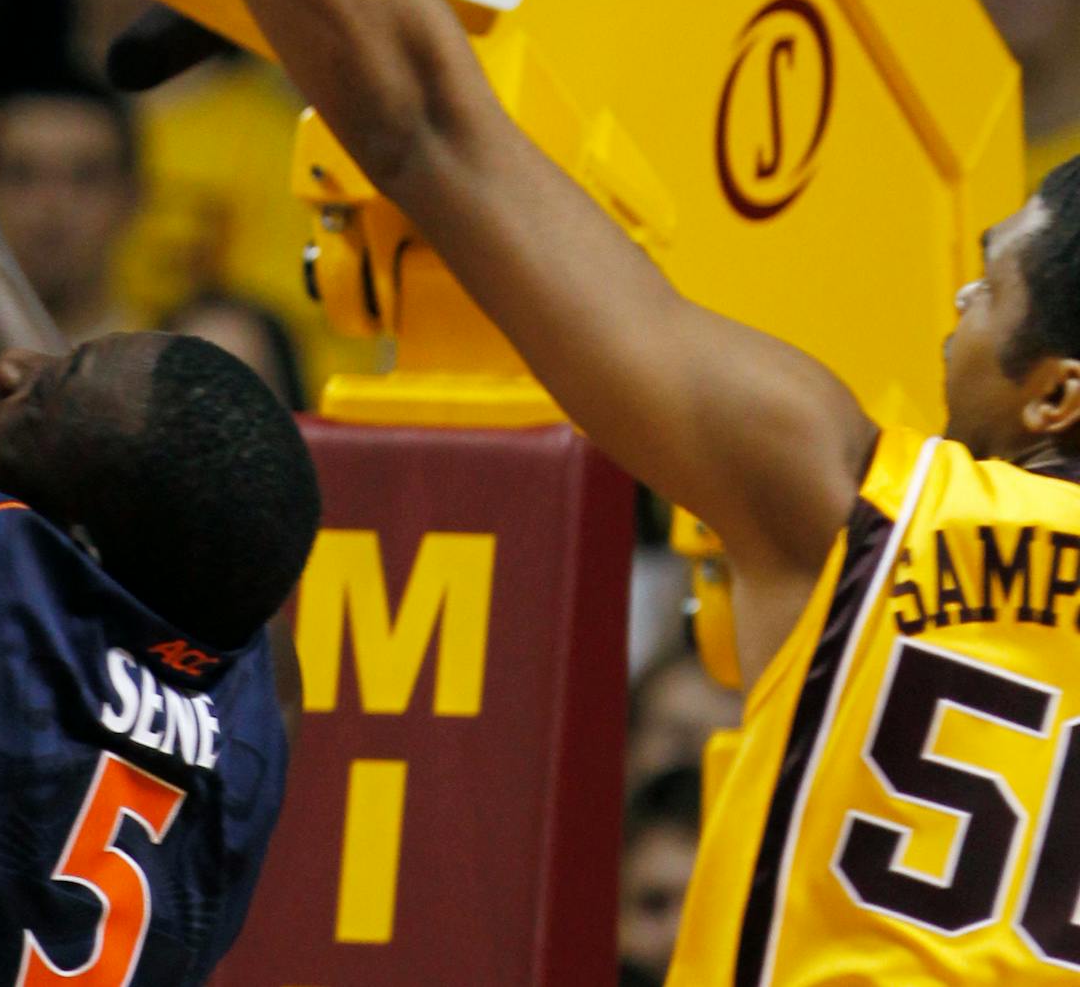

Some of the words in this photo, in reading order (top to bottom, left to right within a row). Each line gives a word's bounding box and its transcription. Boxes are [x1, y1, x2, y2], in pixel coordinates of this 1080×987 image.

[888, 525, 1080, 635] SAMP
[101, 647, 220, 770] SENE
[15, 749, 187, 987] 5
